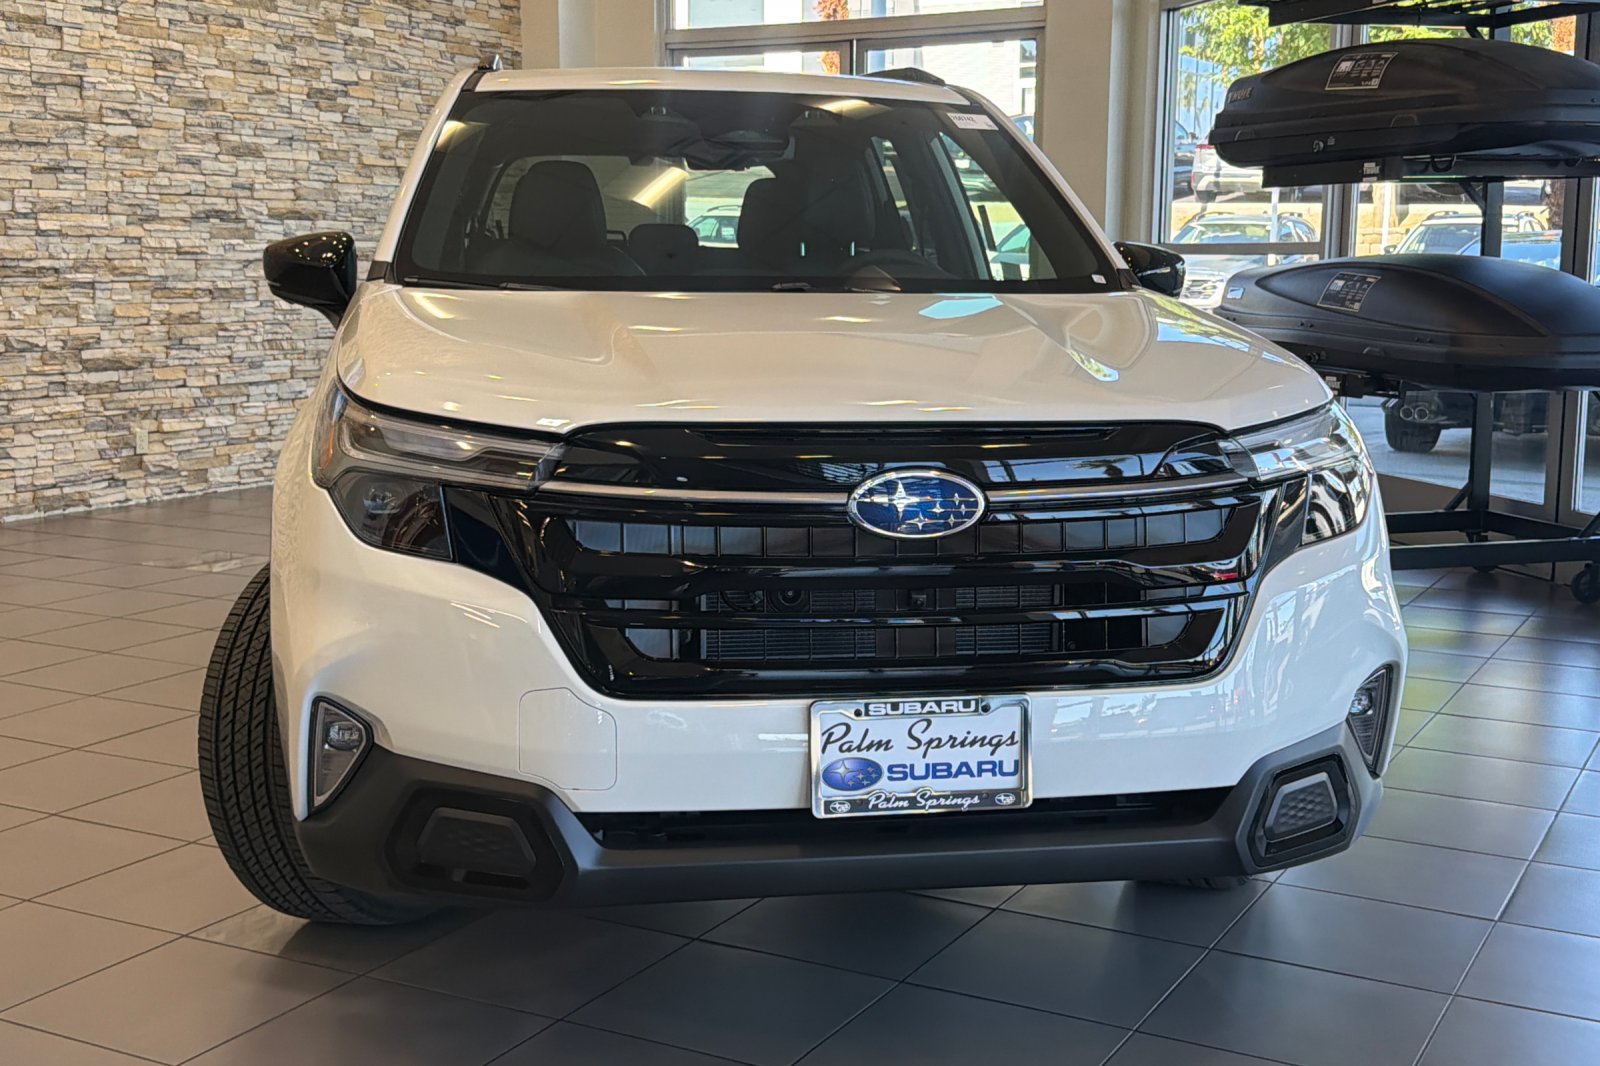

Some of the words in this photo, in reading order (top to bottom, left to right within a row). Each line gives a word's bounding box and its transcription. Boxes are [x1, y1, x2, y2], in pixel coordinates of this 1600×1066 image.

[868, 700, 976, 716] SUBARU
[821, 722, 894, 755] Palm
[907, 718, 1019, 759] Springs
[887, 760, 1019, 782] SUBARU
[868, 791, 909, 810] Palm
[916, 789, 980, 812] Springs
